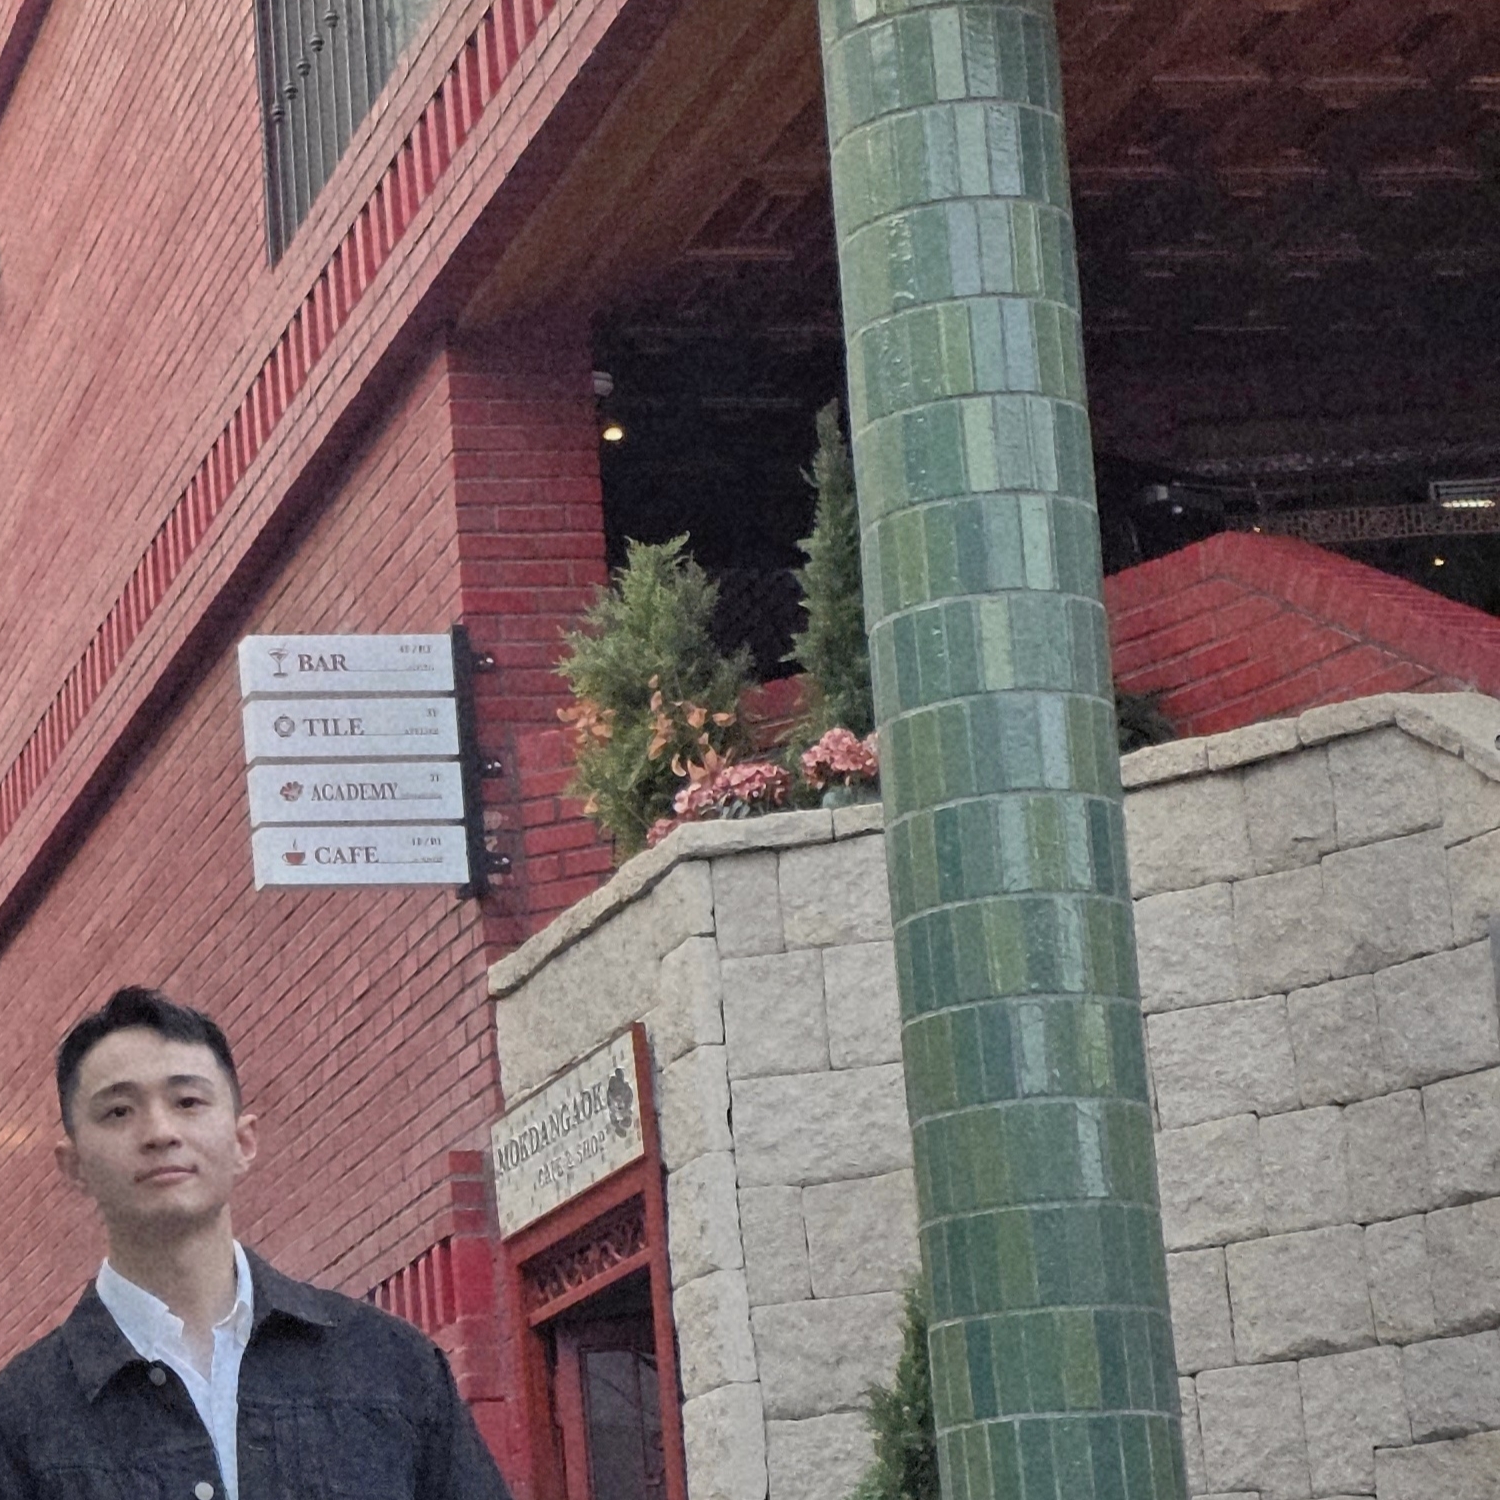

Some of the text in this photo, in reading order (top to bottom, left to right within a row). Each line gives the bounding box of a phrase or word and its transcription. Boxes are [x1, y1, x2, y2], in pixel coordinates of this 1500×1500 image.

[298, 654, 349, 672] BAR
[303, 718, 365, 737] TILE
[311, 783, 398, 801] ACADEMY
[315, 846, 380, 864] CAFE
[497, 1082, 607, 1175] MOKDANGAOK
